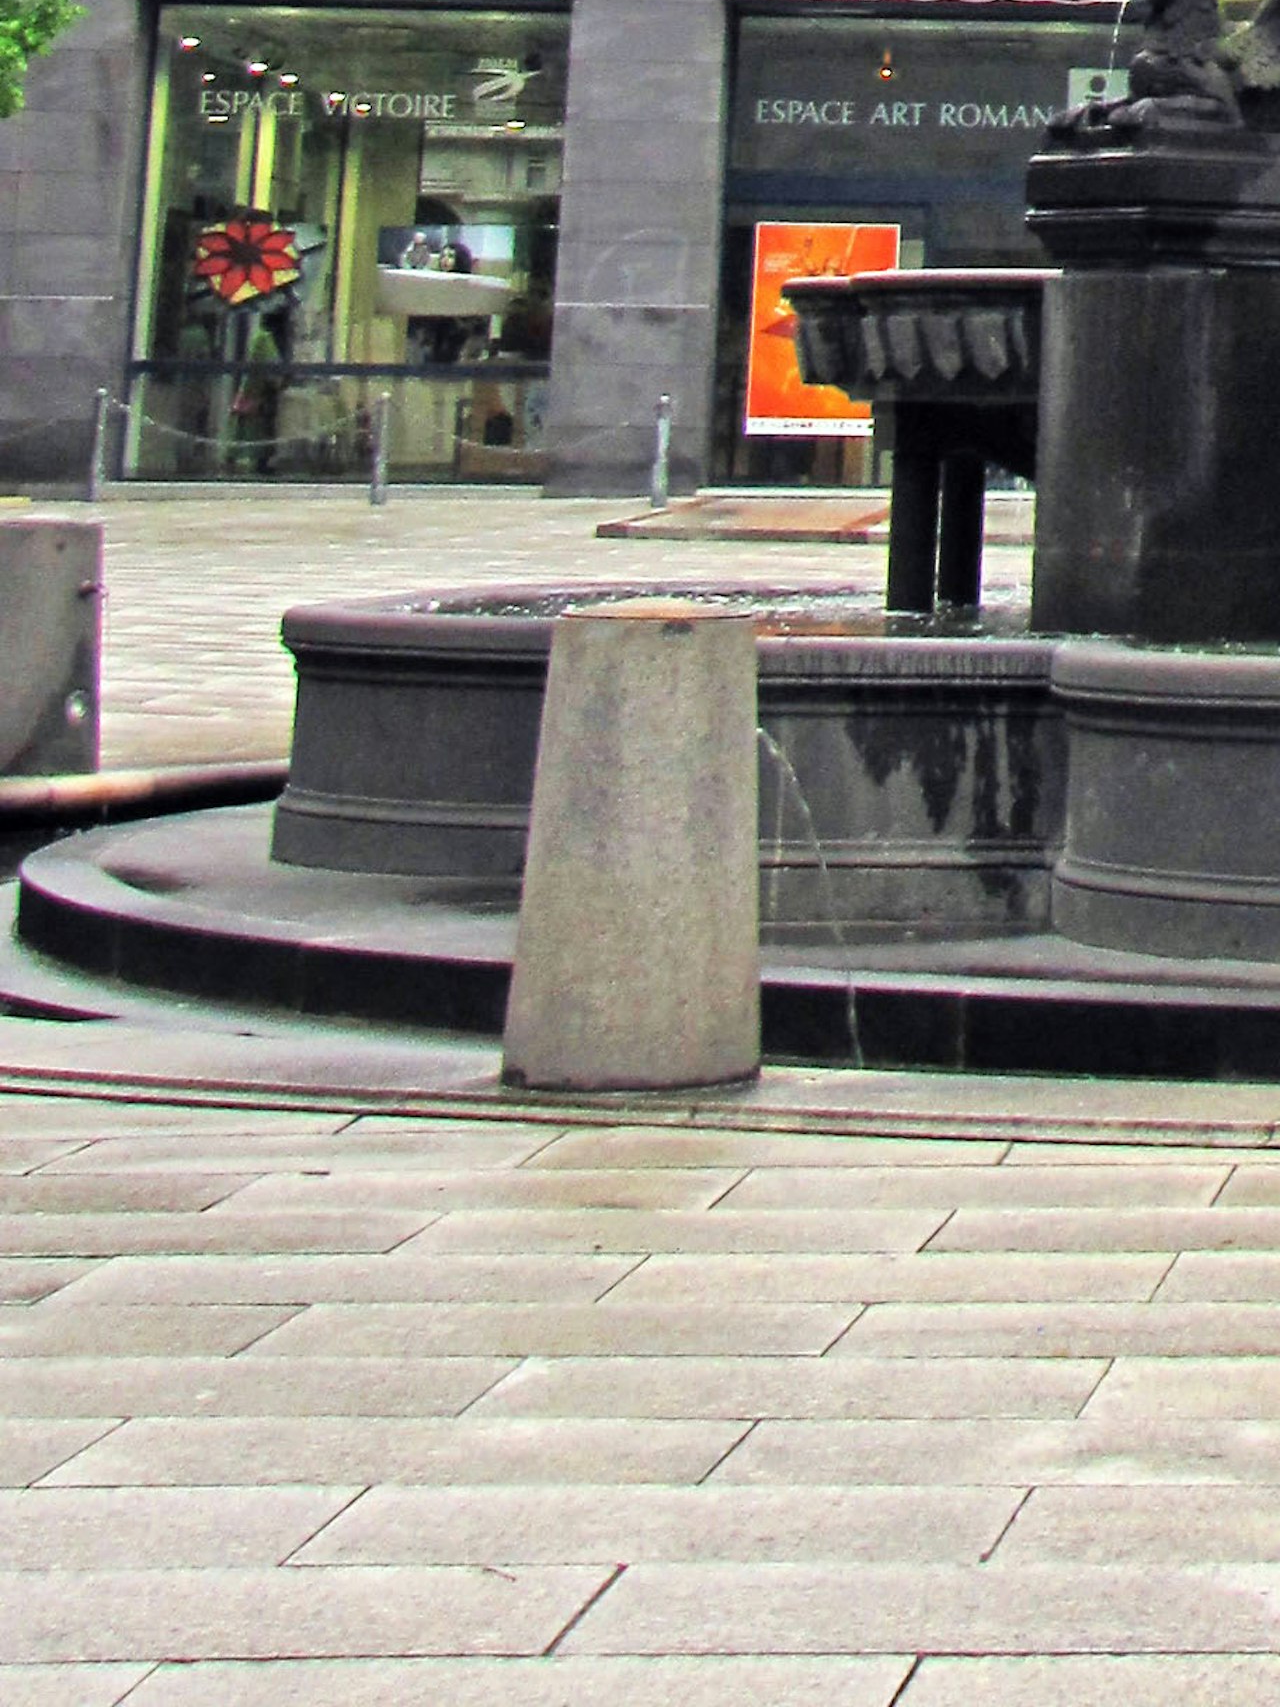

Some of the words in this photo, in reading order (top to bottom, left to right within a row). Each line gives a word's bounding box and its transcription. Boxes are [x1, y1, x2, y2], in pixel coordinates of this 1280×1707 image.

[199, 90, 304, 116] ESPACE
[324, 91, 458, 119] VICTOIRE
[754, 98, 855, 125] ESPACE
[869, 101, 928, 126] ART
[938, 102, 1054, 128] ROMAN
